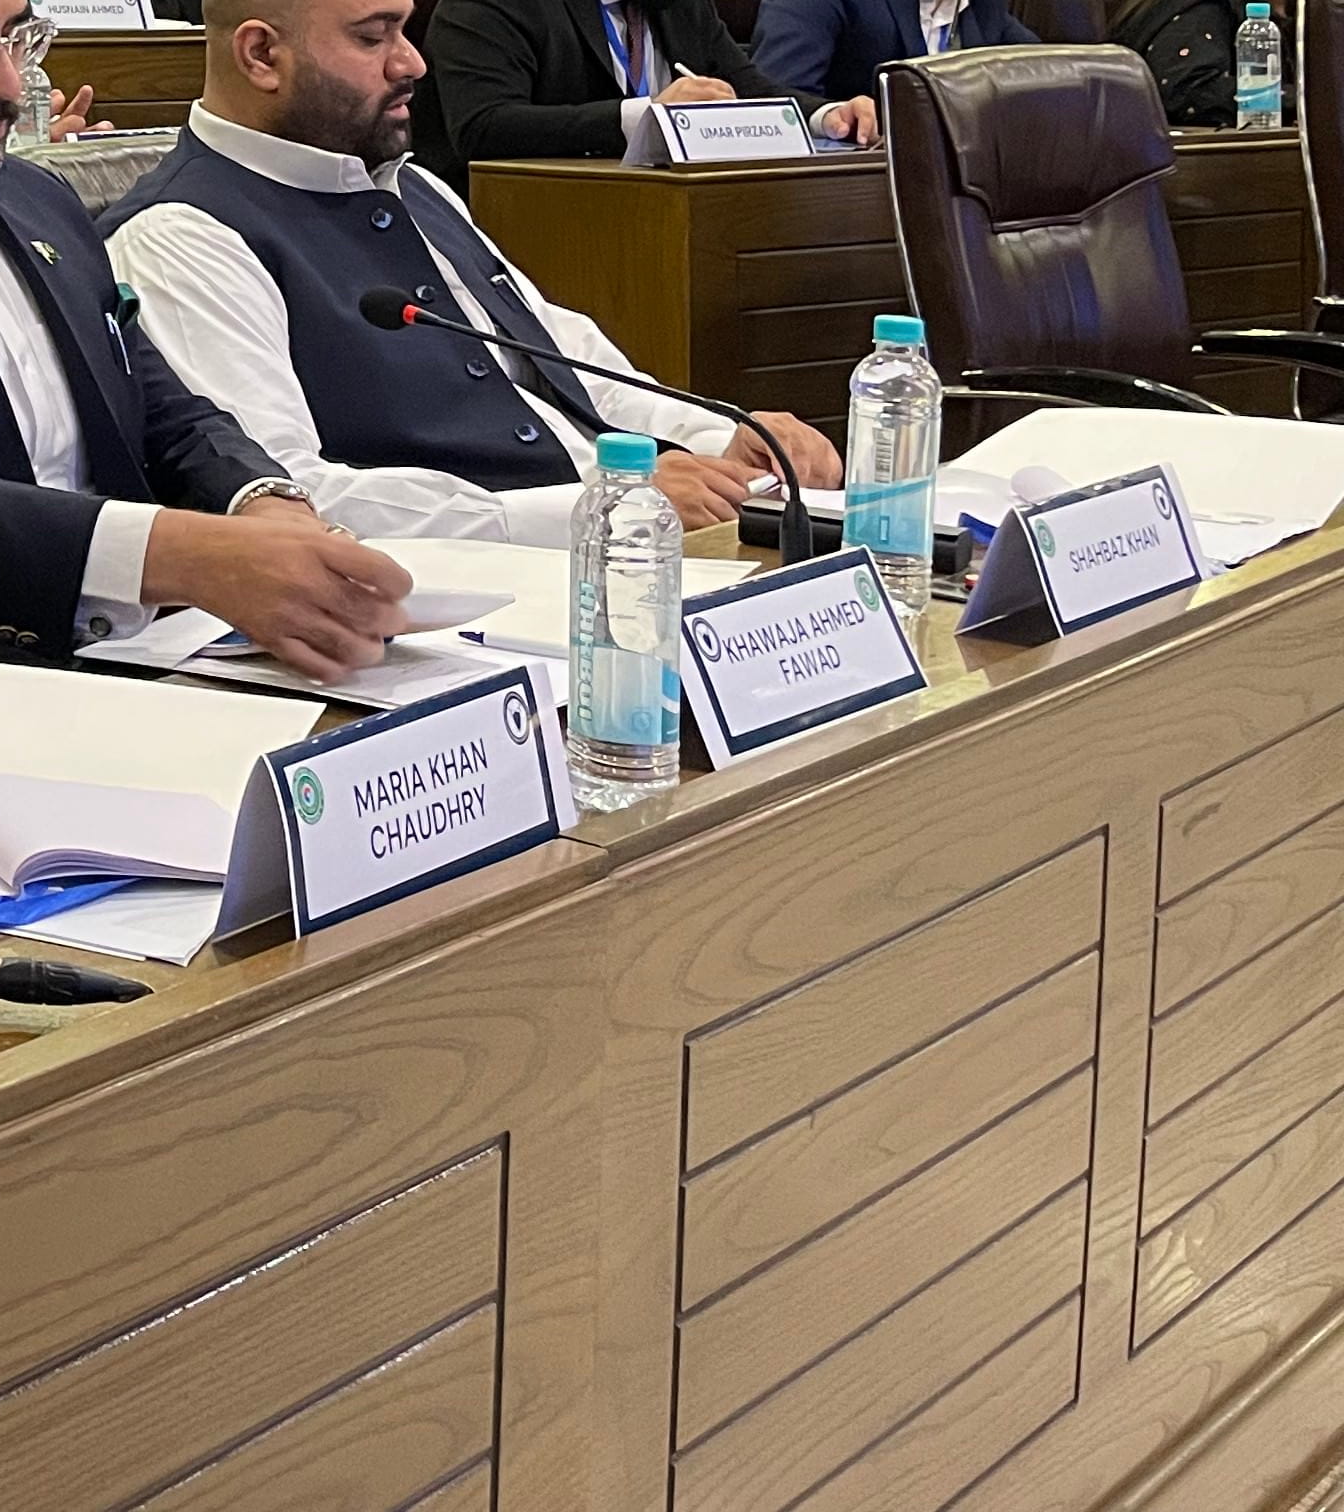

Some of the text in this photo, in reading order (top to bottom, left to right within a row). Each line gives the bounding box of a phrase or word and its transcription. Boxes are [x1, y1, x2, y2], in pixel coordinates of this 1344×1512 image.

[91, 5, 124, 14] AHMED
[699, 124, 783, 139] UMAR PIRZADA
[1069, 523, 1160, 573] SHAHBAZ KHAN
[722, 600, 865, 664] KHAWAJA AHMED
[779, 645, 841, 685] FAWAD
[354, 737, 488, 818] MARIA KHAN
[370, 783, 485, 859] CHAUDHRY
